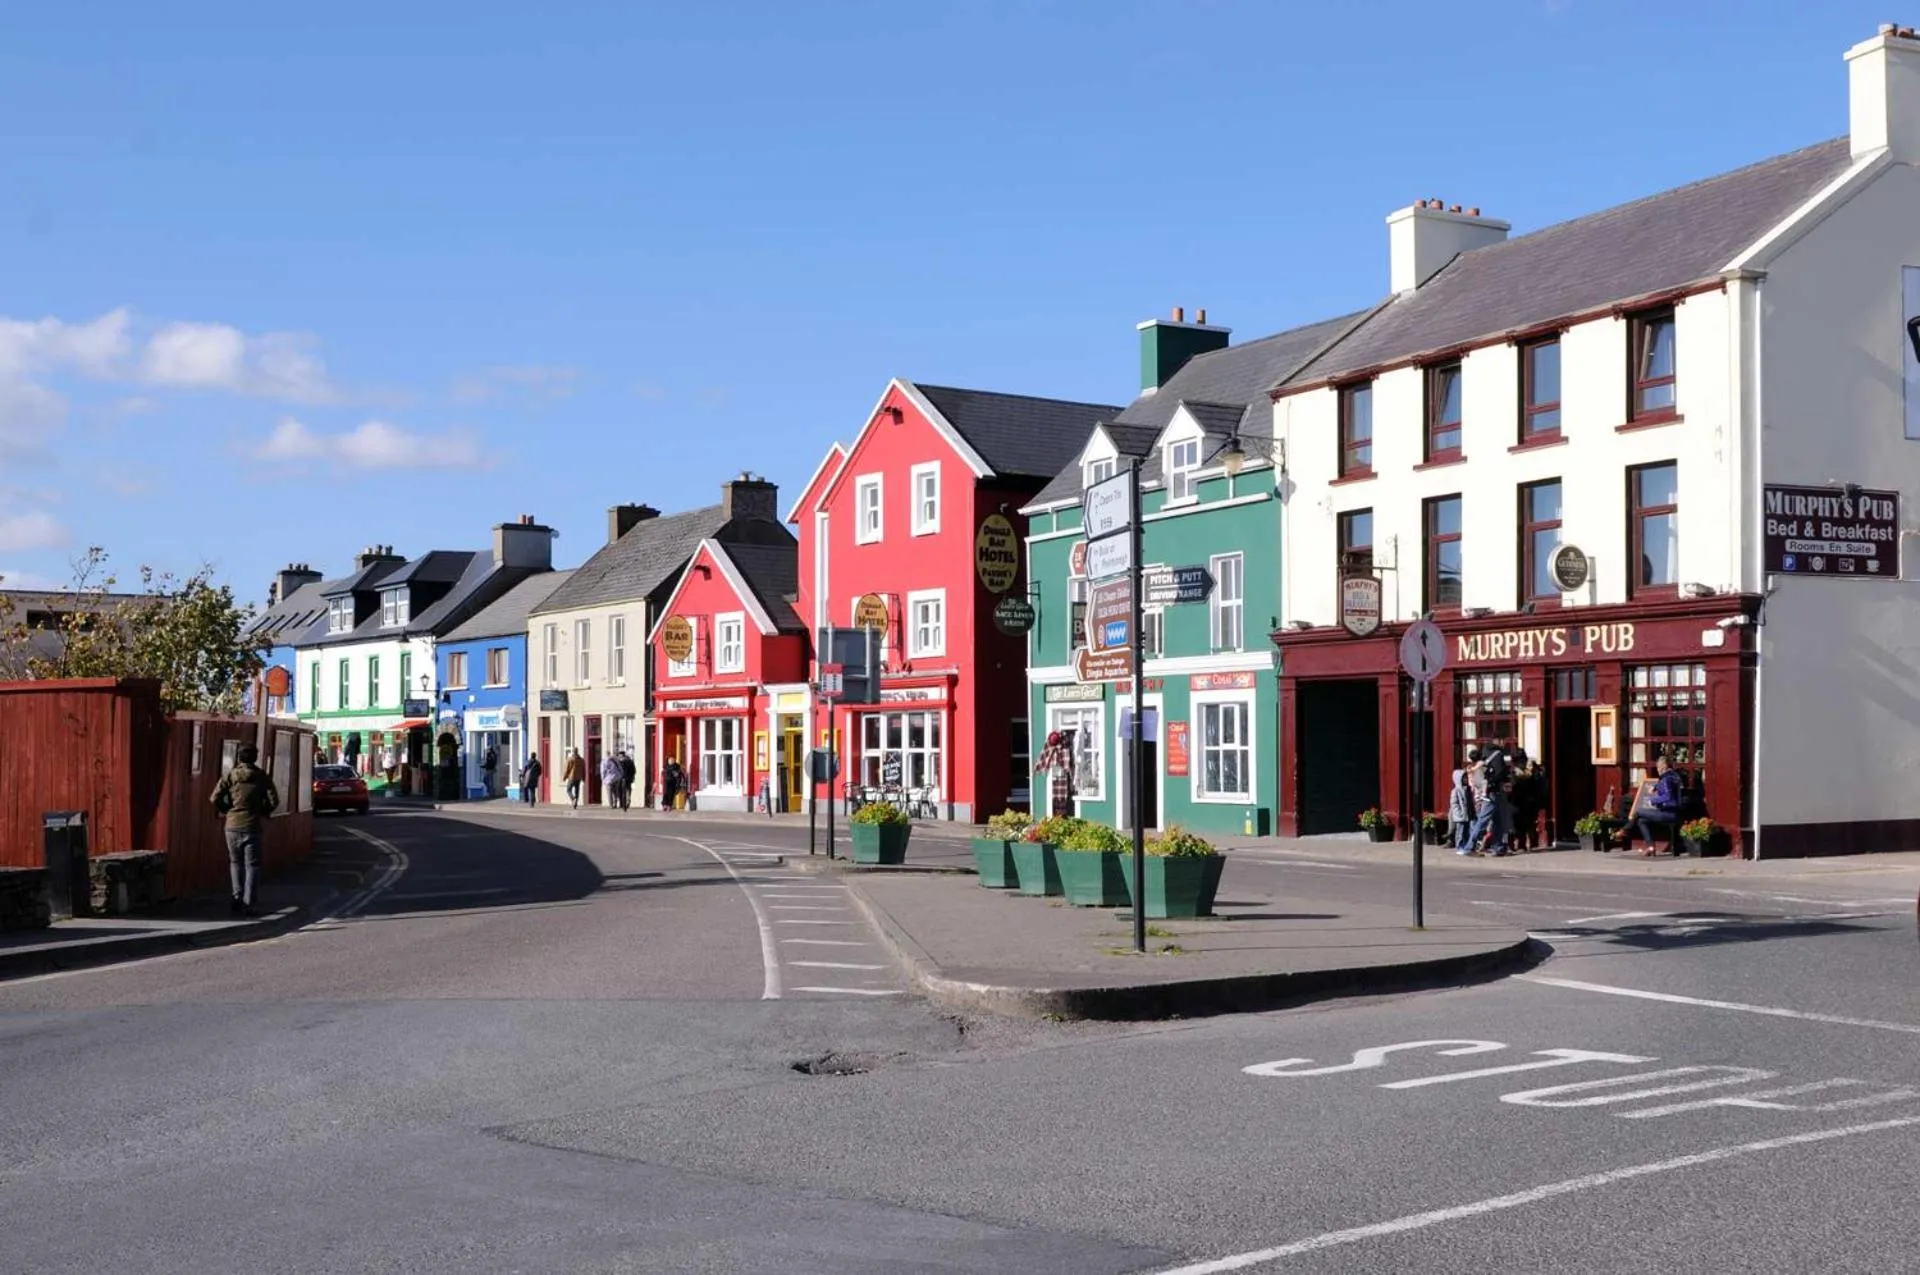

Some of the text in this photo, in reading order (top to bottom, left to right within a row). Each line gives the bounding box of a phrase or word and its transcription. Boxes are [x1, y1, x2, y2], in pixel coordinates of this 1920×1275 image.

[1766, 490, 1894, 521] MURPHY'S PUB
[1767, 520, 1894, 541] Bed & Breakfast
[979, 547, 1016, 563] HOTEL
[1789, 541, 1872, 554] Rooms En Suite
[1150, 571, 1202, 585] PITCH & PUTT
[1150, 588, 1202, 601] DRIVING RANGE
[665, 631, 688, 640] BAR
[1458, 623, 1635, 661] MURPHY'S PUB
[1241, 1040, 1917, 1119] STOP
